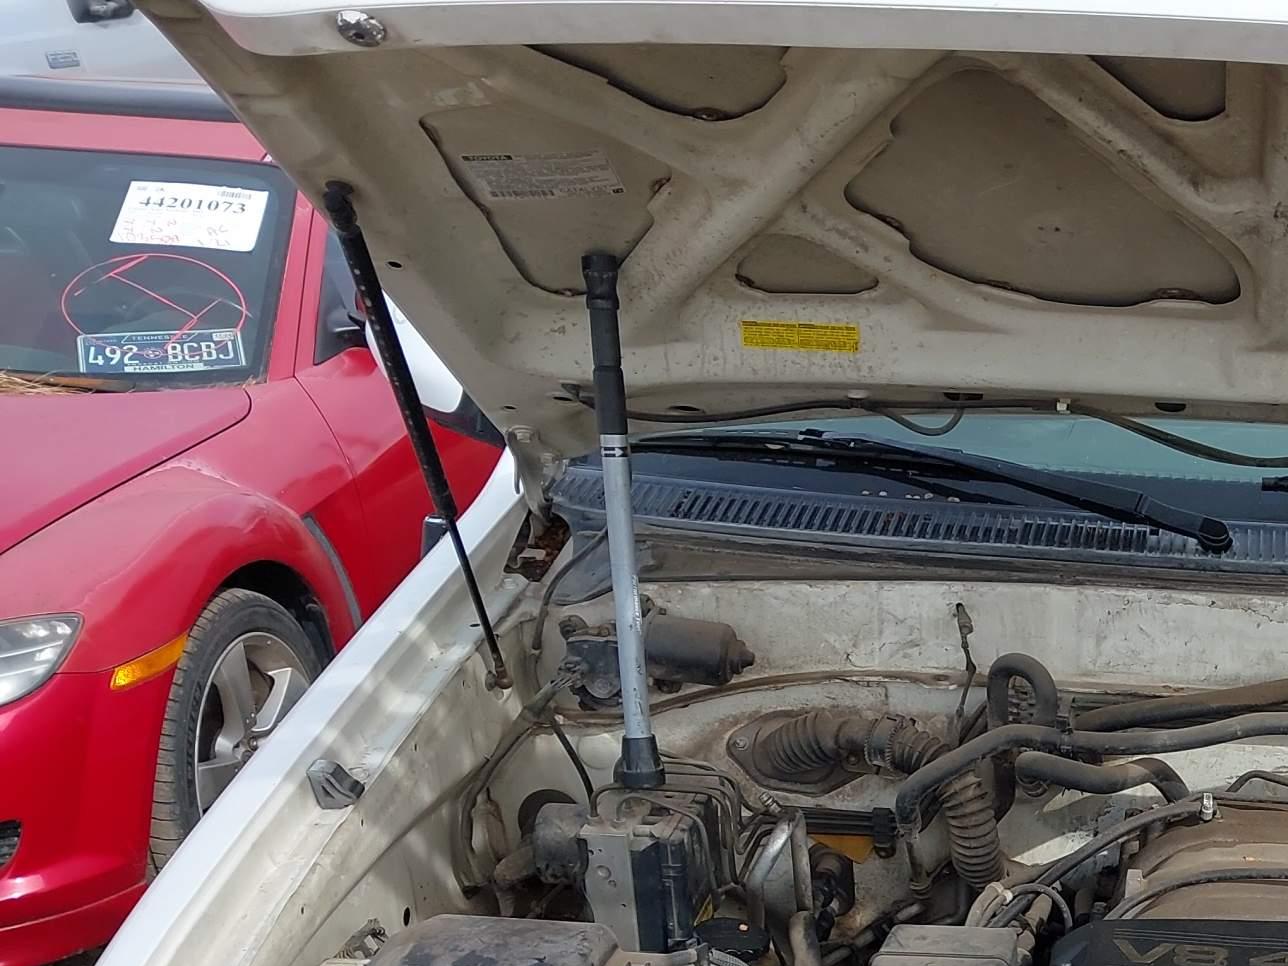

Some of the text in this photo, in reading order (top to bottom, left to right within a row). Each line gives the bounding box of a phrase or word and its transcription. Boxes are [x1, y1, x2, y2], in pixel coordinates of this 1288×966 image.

[138, 196, 247, 214] 44201073
[88, 345, 140, 366] 492
[133, 363, 195, 372] HAMILTON
